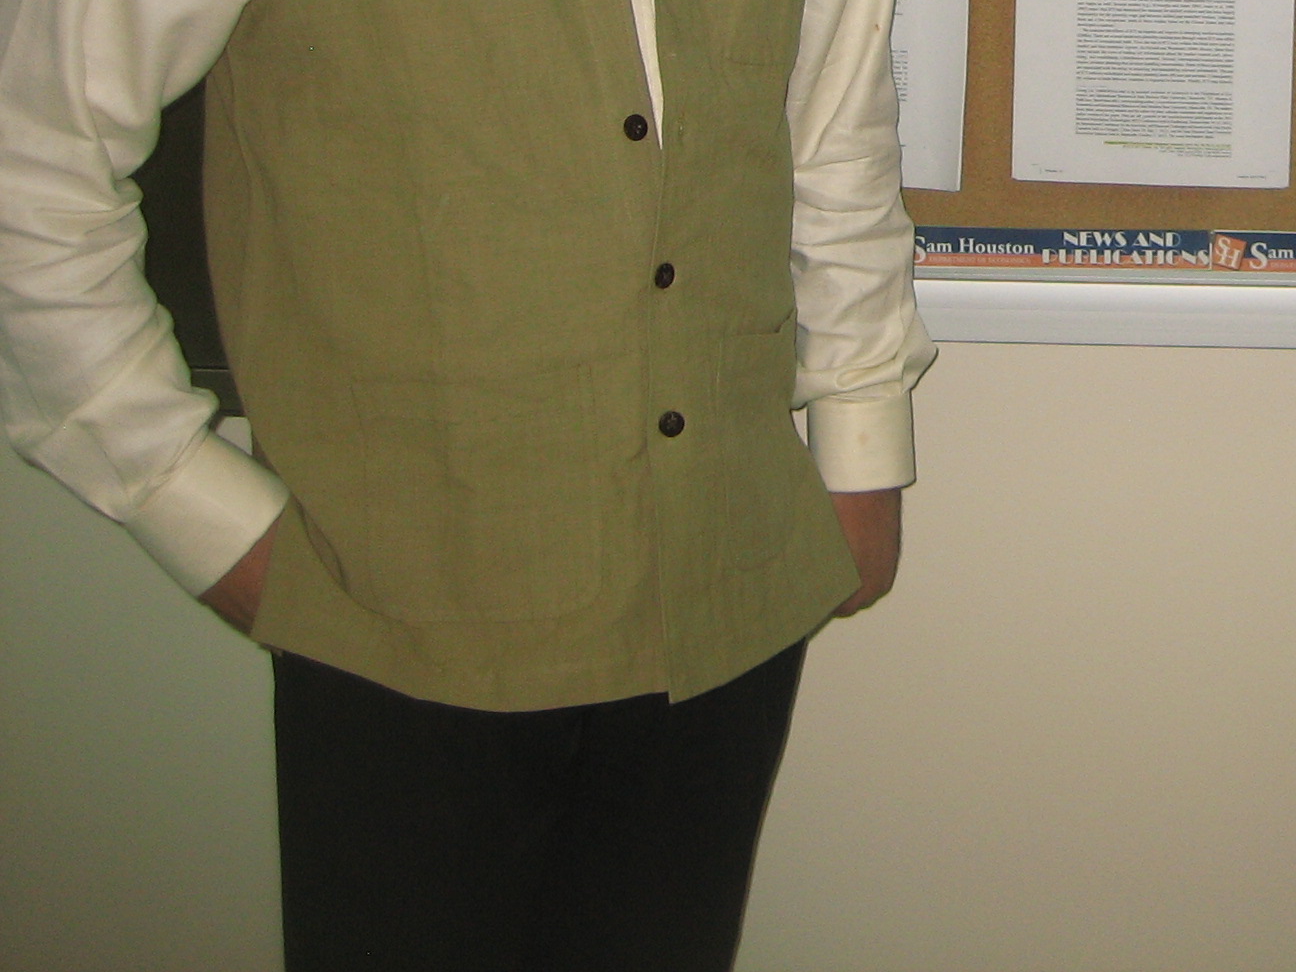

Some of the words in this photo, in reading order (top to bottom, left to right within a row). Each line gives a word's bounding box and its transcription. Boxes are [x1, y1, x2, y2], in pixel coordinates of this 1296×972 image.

[959, 237, 1035, 255] Houston
[1063, 231, 1126, 247] NEWS
[1132, 232, 1182, 248] AND
[1041, 247, 1211, 266] PUBLICATIONS
[1249, 241, 1294, 270] Sam
